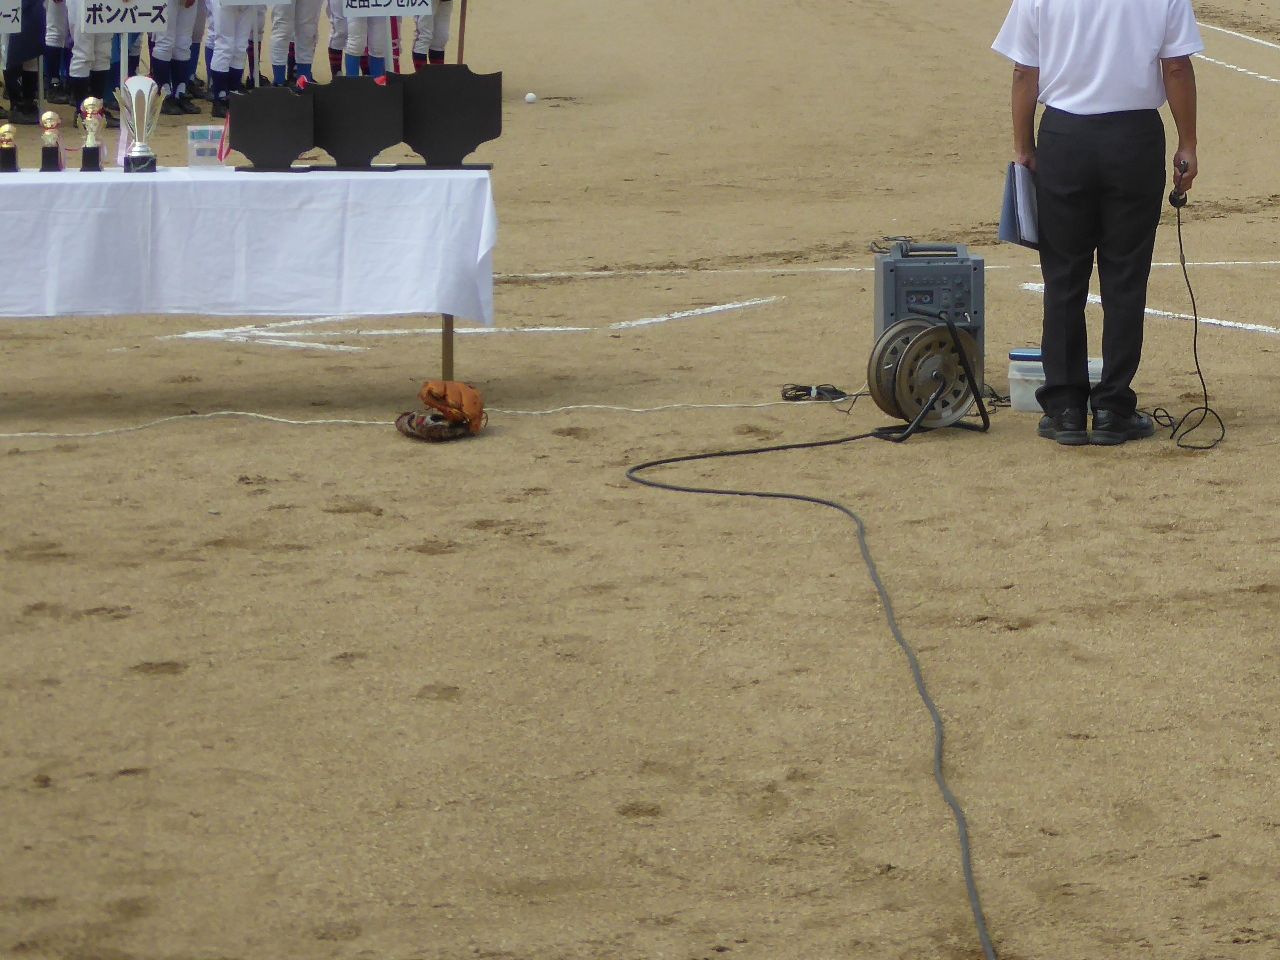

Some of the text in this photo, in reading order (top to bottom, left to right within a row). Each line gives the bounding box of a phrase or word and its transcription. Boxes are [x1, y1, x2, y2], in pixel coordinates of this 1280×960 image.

[0, 6, 20, 24] ーズ
[86, 2, 168, 25] ボンバーズ
